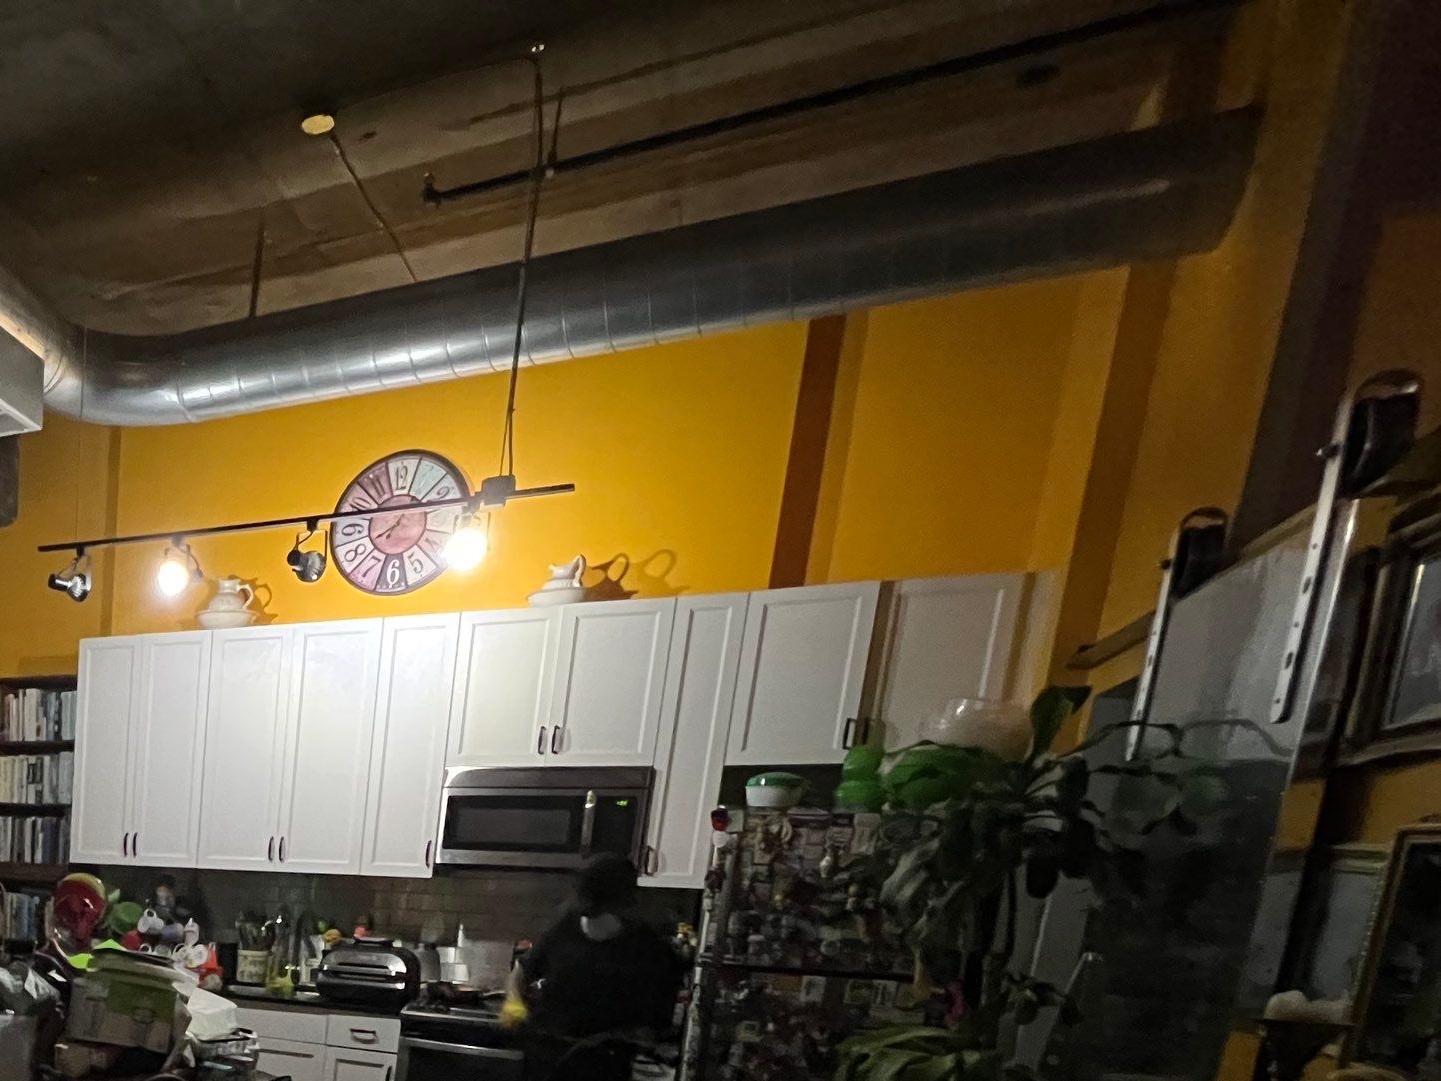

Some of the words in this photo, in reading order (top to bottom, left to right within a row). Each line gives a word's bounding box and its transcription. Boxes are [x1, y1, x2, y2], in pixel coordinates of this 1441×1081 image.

[394, 464, 408, 491] 12
[341, 523, 365, 537] 9
[344, 543, 367, 563] 8
[407, 551, 424, 574] 5
[362, 555, 383, 578] 7
[386, 558, 400, 589] 6
